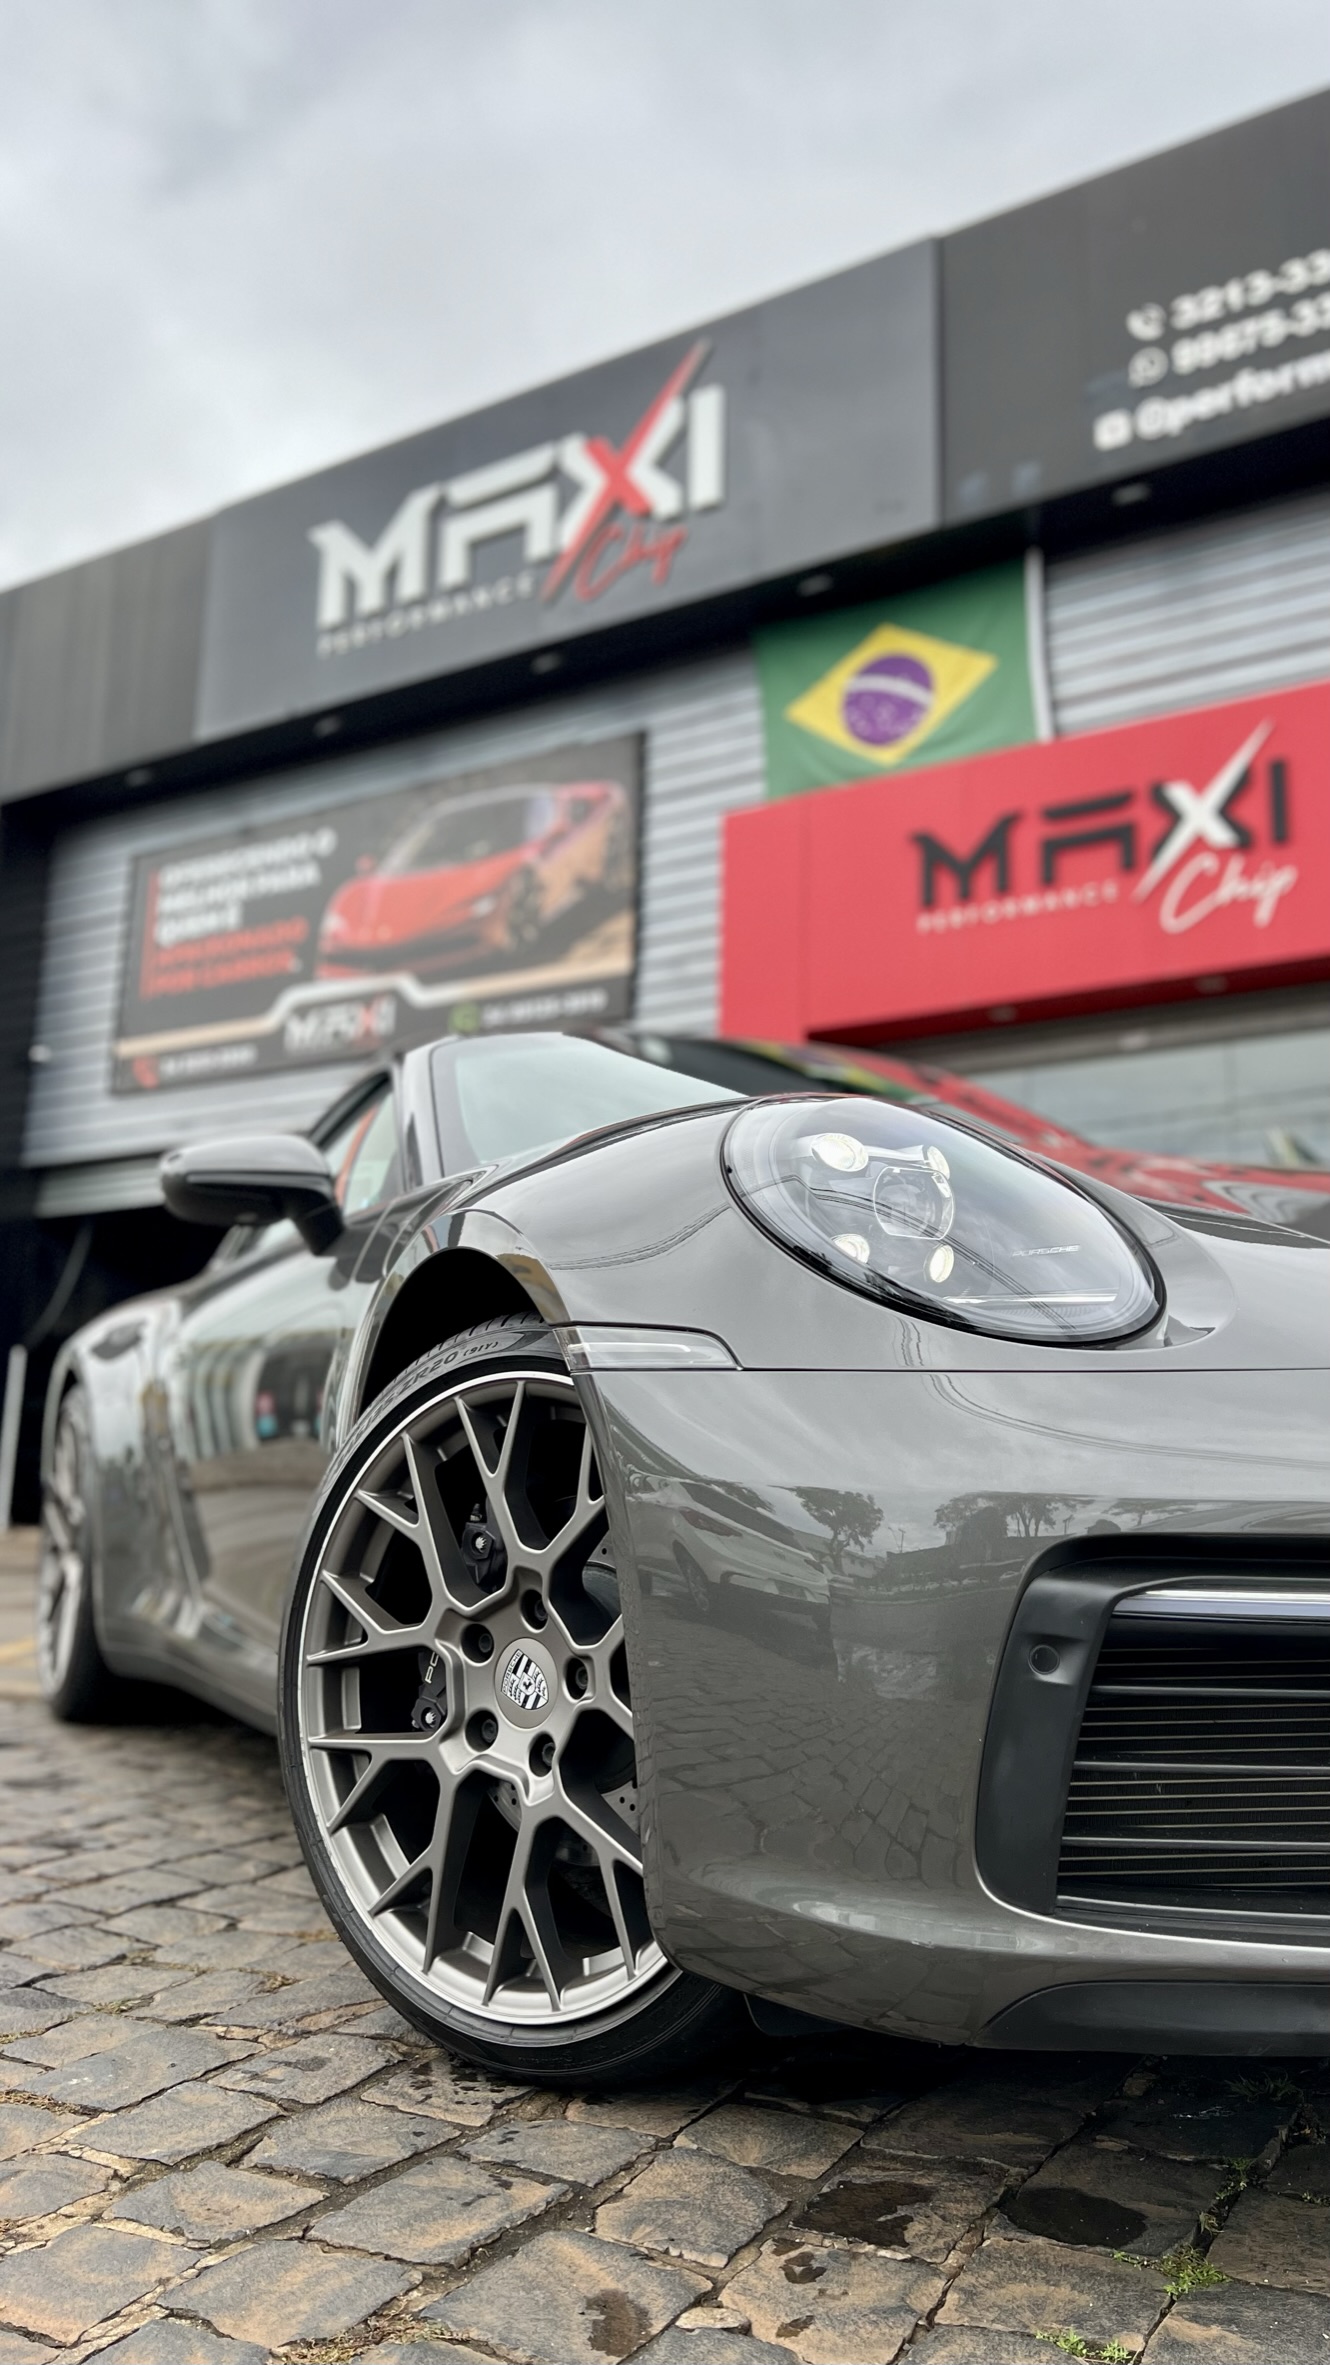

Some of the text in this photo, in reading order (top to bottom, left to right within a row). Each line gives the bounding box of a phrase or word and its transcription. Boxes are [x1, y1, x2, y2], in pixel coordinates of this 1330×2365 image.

[307, 336, 726, 632] MAXI
[315, 571, 536, 659] PERFORMANCE
[909, 716, 1289, 908] MAXI
[915, 878, 1120, 935] PERFORMANCE
[1158, 851, 1299, 935] Chip
[1011, 1245, 1080, 1257] PORSCHE
[401, 1352, 458, 1395] ZR20
